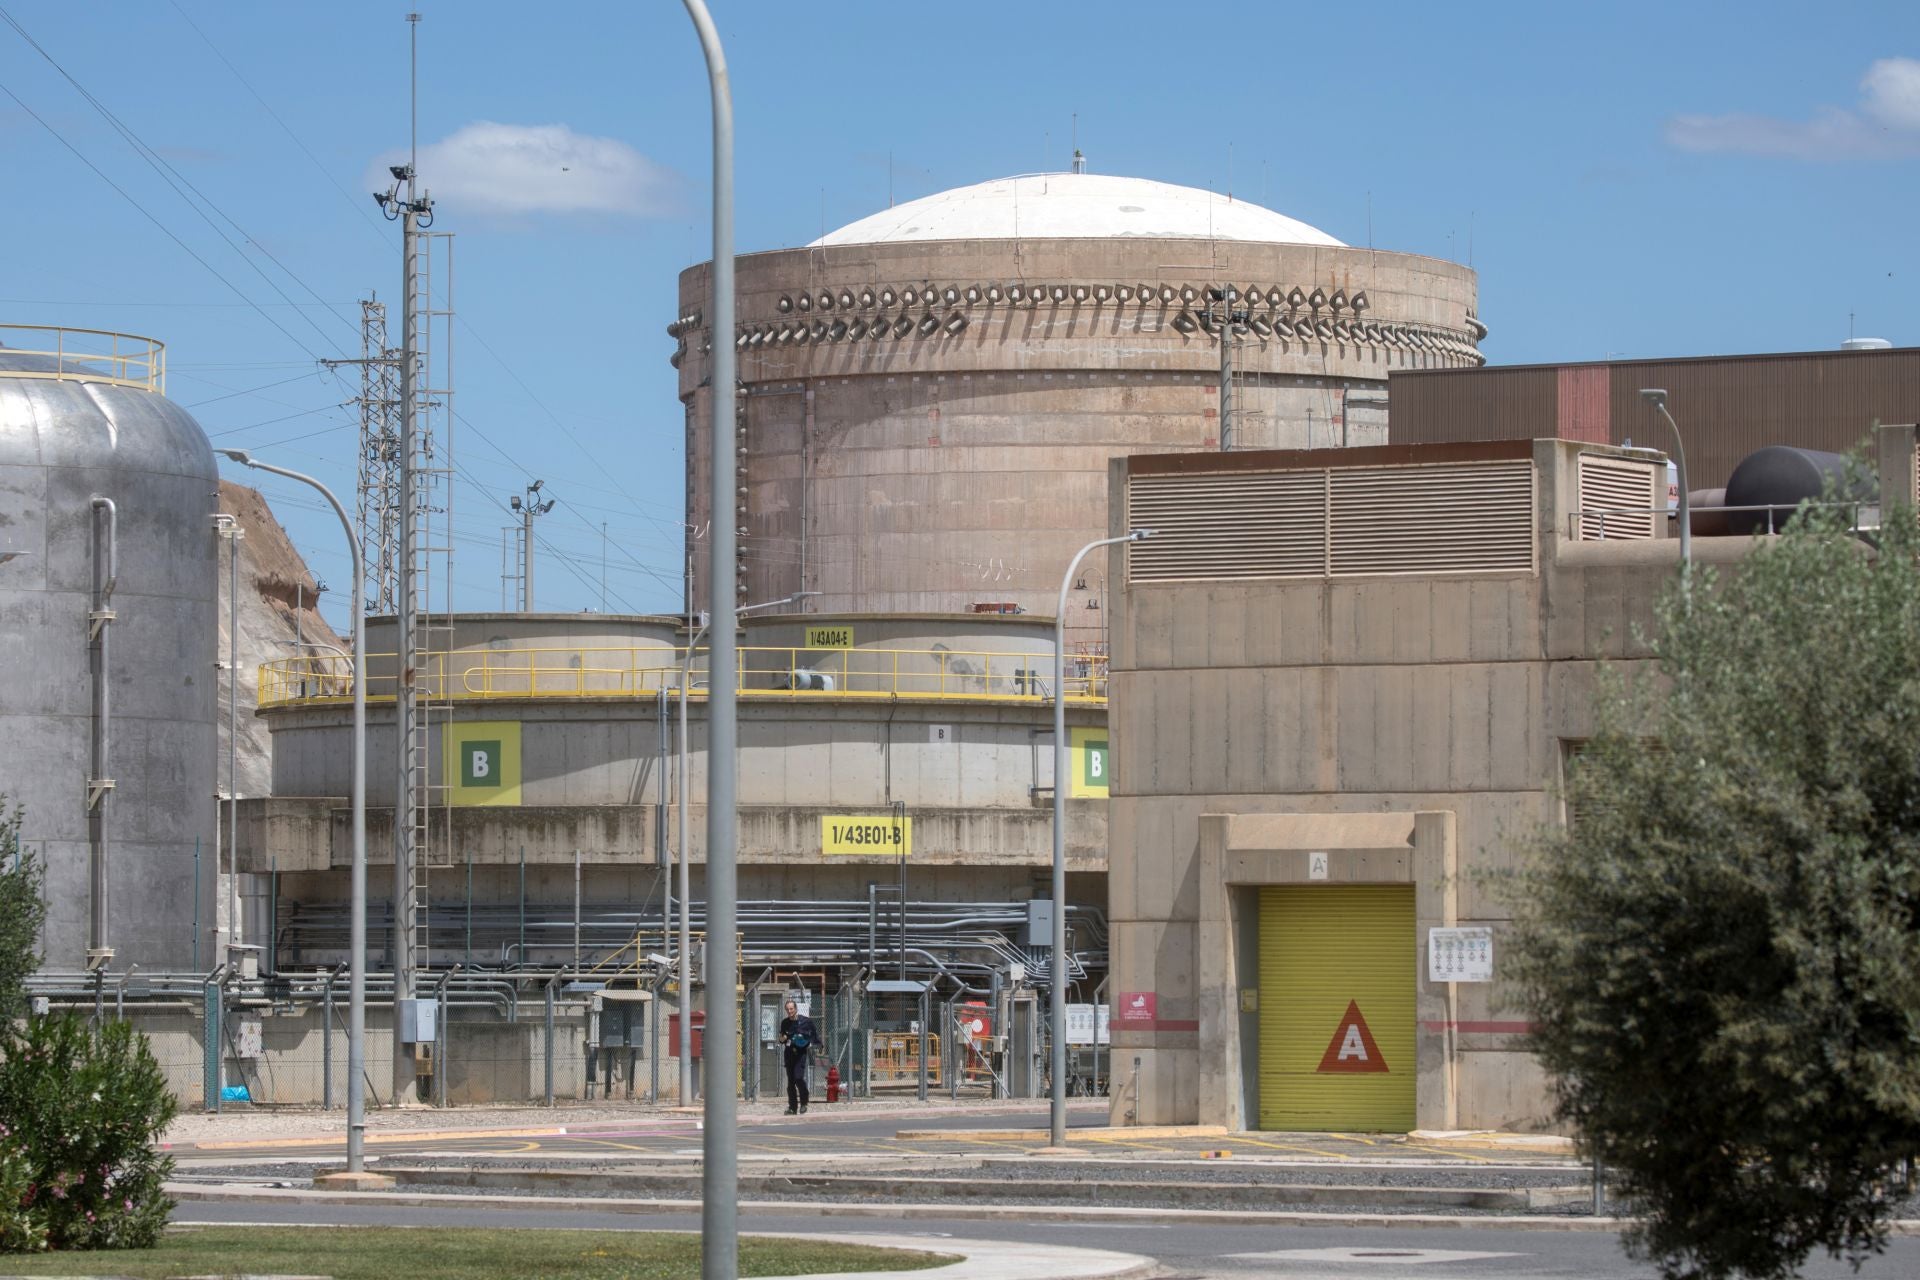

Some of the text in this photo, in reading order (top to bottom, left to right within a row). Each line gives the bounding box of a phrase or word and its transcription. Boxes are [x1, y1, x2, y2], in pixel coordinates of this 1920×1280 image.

[811, 631, 847, 646] 1/43A04-E
[939, 728, 945, 739] B
[473, 750, 489, 777] B
[1091, 751, 1102, 777] B
[832, 825, 902, 844] 1/43E01-B
[1313, 856, 1324, 872] A
[1338, 1024, 1368, 1060] A
